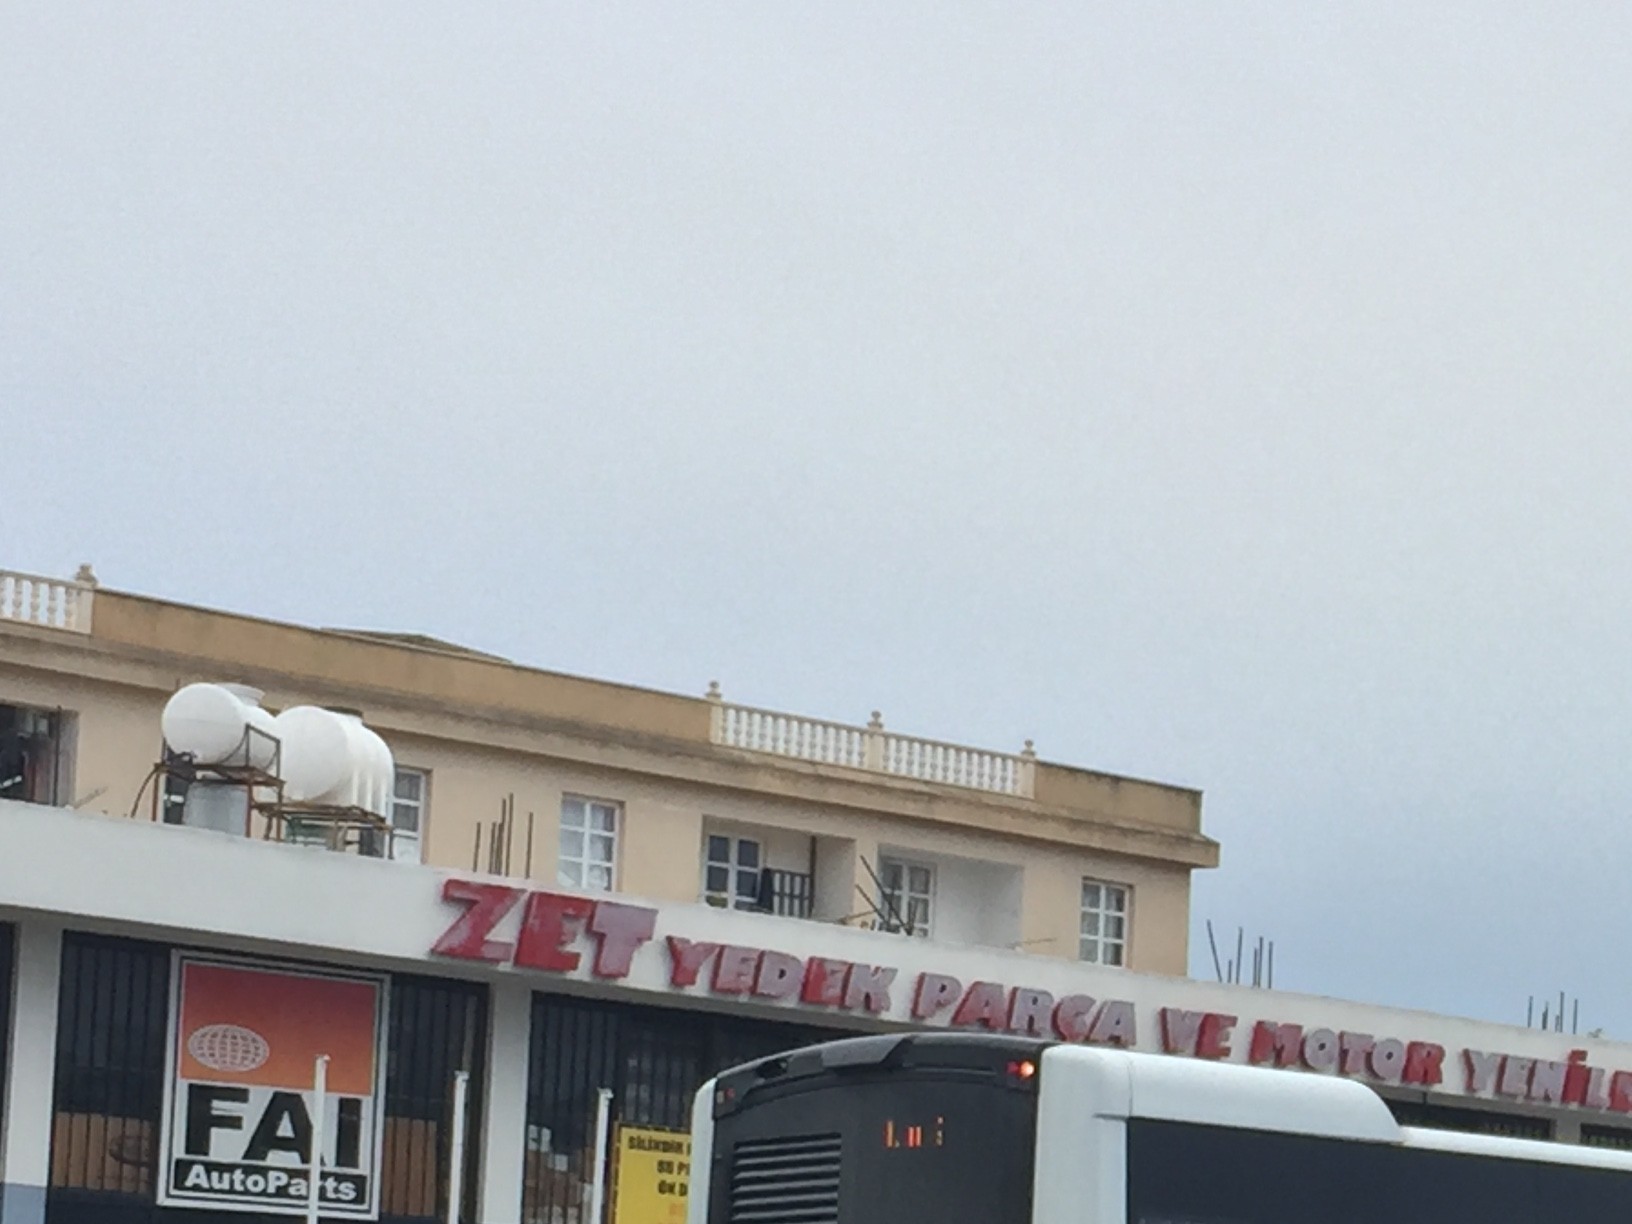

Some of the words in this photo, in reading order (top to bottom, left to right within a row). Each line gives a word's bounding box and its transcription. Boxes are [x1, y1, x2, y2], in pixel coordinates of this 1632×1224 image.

[430, 877, 659, 979] ZET
[666, 935, 899, 1014] YEDEK
[1159, 1006, 1239, 1060] VE
[1249, 1019, 1446, 1086] MOTOR
[185, 1083, 363, 1170] FAI
